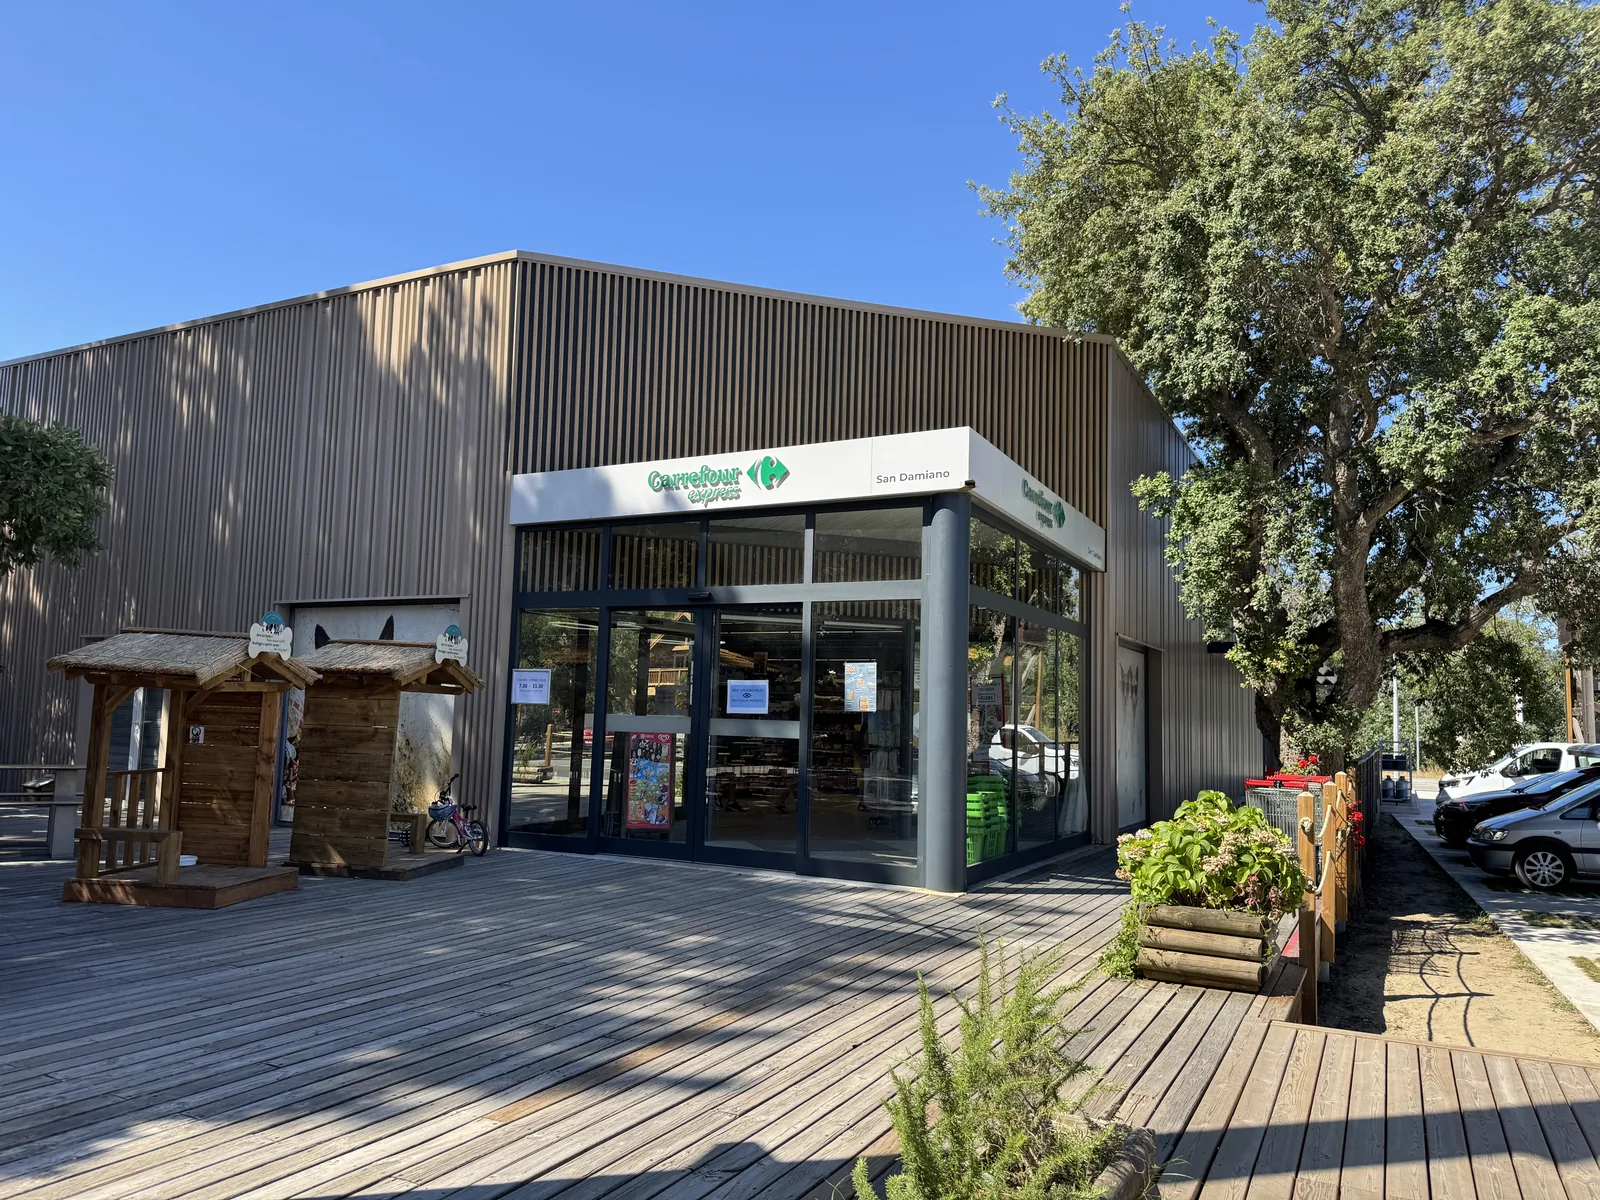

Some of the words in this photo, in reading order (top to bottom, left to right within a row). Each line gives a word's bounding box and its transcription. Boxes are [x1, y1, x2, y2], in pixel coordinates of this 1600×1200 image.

[648, 465, 740, 490] Carrefour
[876, 474, 896, 484] San
[899, 469, 950, 482] Damiano
[688, 486, 741, 506] express
